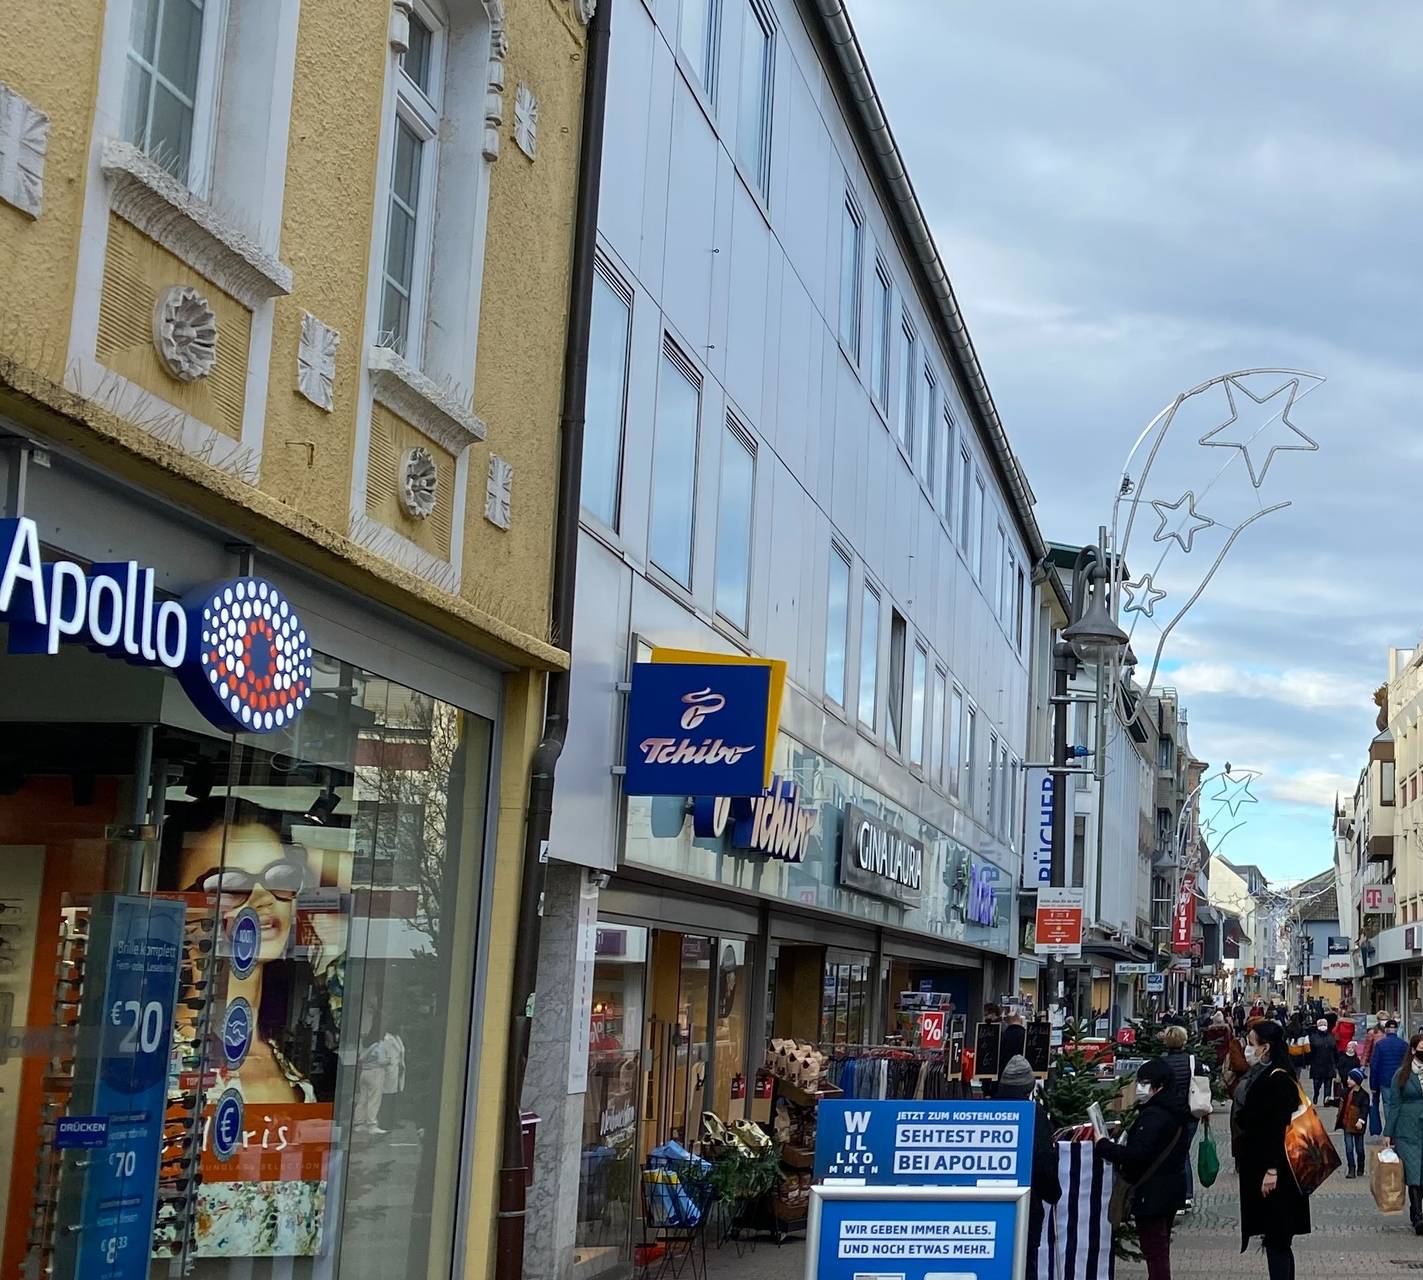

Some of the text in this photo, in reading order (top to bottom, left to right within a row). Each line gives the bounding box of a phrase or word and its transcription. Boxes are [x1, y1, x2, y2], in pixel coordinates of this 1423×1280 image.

[0, 517, 187, 669] Apollo
[639, 737, 756, 765] Tchibo
[897, 1111, 1020, 1121] JETZT ZUM KOSTENLOSEN
[59, 1122, 106, 1133] DRÜCKEN
[900, 1129, 1014, 1144] SEHTEST PRO
[899, 1155, 1012, 1171] BEI APOLLO
[845, 1225, 992, 1235] WIR GEBEN IMMER ALLES.
[843, 1244, 990, 1254] UND NOCH ETWAS MEHR.
